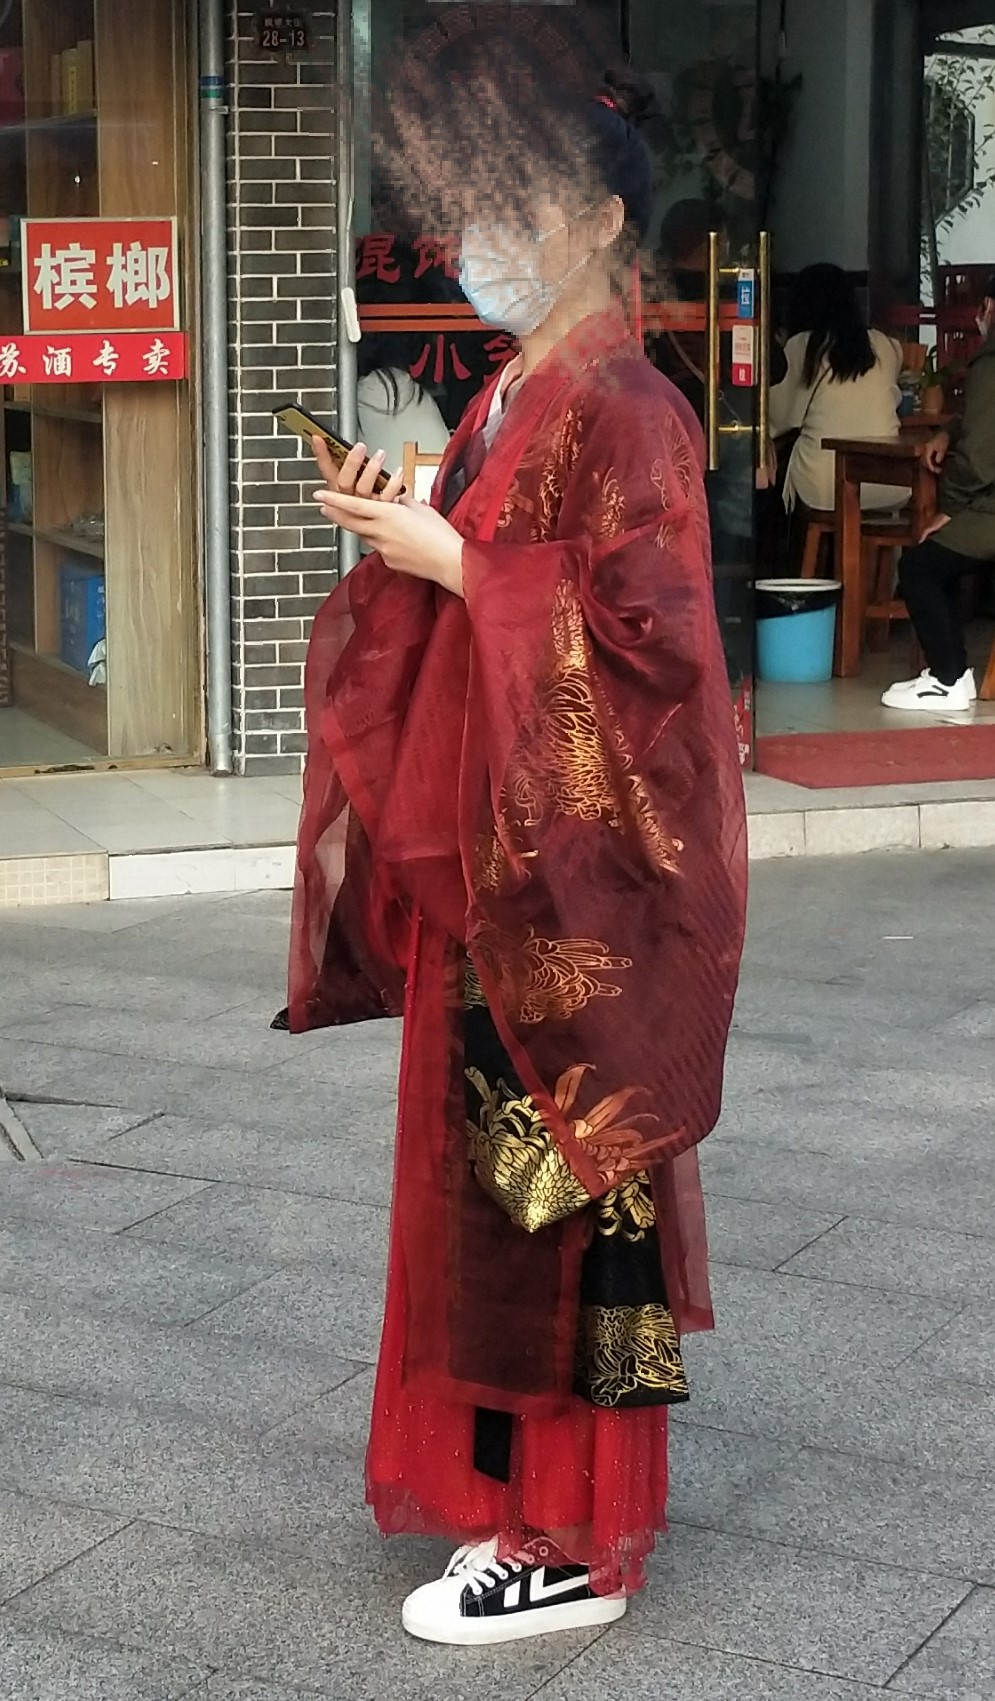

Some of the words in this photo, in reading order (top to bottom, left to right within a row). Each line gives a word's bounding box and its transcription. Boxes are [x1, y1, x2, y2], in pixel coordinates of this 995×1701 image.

[263, 30, 305, 47] 28-13
[33, 241, 171, 310] 槟榔
[0, 338, 171, 378] 苏酒专卖
